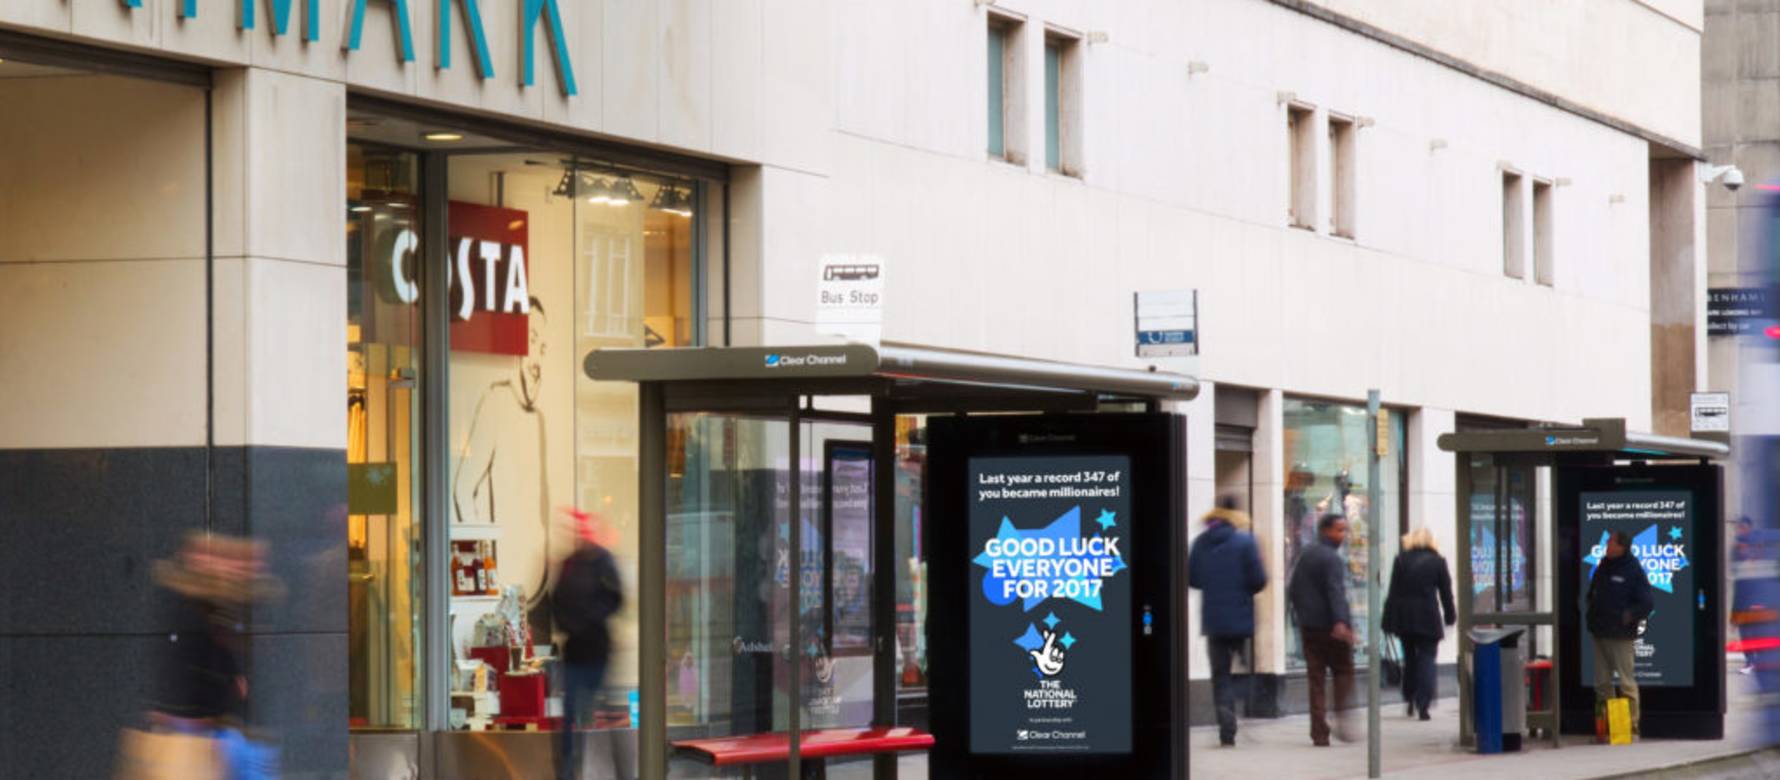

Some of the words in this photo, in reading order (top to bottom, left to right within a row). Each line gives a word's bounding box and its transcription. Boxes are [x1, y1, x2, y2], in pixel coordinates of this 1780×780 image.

[392, 229, 530, 321] CSTA
[821, 290, 843, 304] Bus
[849, 290, 879, 304] Stop
[781, 356, 804, 365] Clear
[806, 353, 847, 365] Channel
[979, 473, 1005, 485] Last
[1007, 474, 1032, 486] year
[1034, 475, 1042, 484] a
[1044, 472, 1081, 484] record
[1083, 471, 1105, 482] 347
[1107, 470, 1121, 482] of
[979, 488, 1001, 502] you
[1002, 487, 1048, 499] became
[1049, 485, 1120, 497] millionaires!
[1586, 502, 1605, 510] Last
[1607, 503, 1624, 512] year
[1632, 502, 1659, 510] record
[1660, 501, 1675, 509] 347
[1676, 501, 1686, 509] of
[985, 537, 1055, 557] GOOD
[1059, 536, 1121, 556] LUCK
[1642, 544, 1685, 557] LUCK
[992, 558, 1114, 578] EVERYONE
[1648, 572, 1673, 585] 017
[1003, 579, 1049, 598] FOR
[1052, 578, 1103, 598] 2017
[1039, 680, 1061, 689] THE
[1024, 689, 1077, 699] NATIONAL
[1027, 699, 1075, 708] LOTTERY
[1029, 731, 1051, 740] Clear
[1052, 730, 1087, 740] Channel
